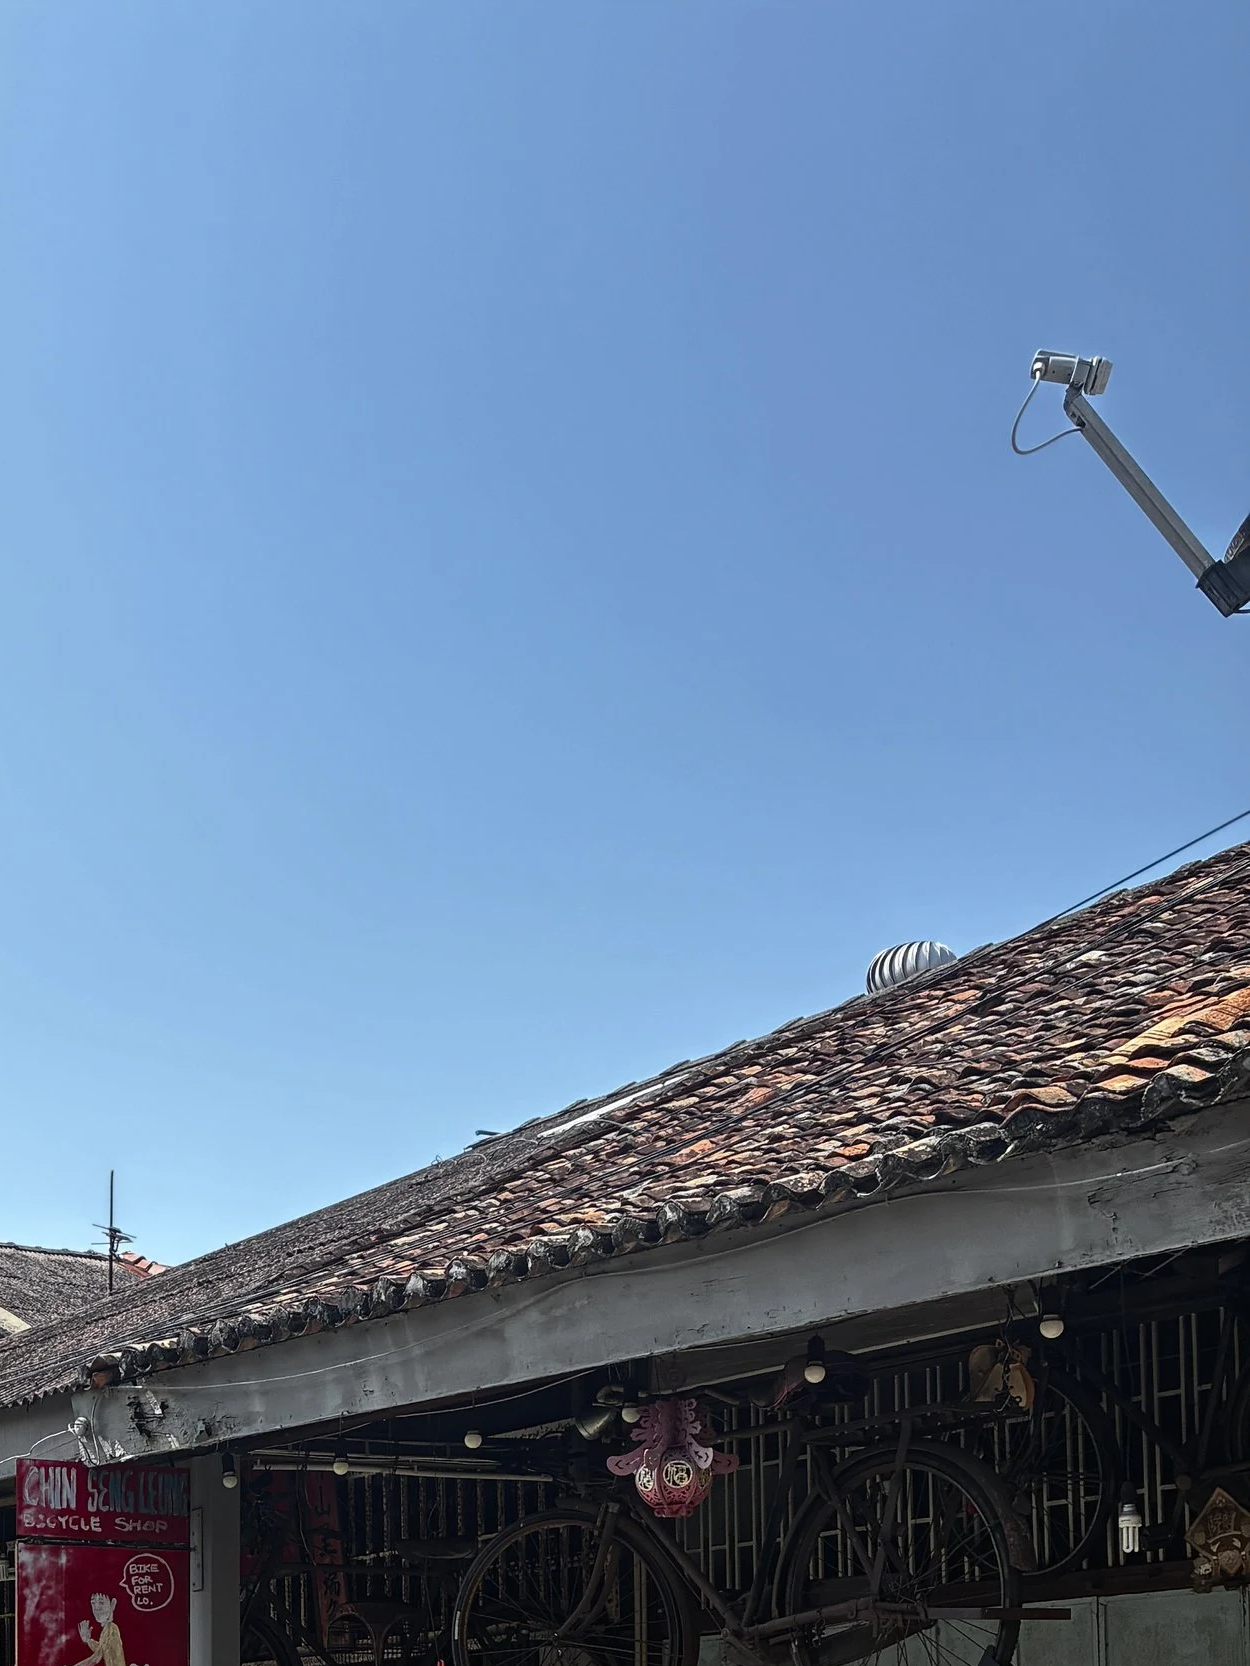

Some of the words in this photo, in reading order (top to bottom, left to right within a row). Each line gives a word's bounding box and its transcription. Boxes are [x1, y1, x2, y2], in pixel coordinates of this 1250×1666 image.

[24, 1466, 77, 1510] CHIN
[87, 1469, 134, 1514] SENG
[23, 1513, 103, 1533] BICYCLE
[114, 1517, 168, 1533] SHOP
[129, 1564, 160, 1574] BIKE
[131, 1575, 153, 1585] FOR
[133, 1583, 163, 1595] RENT
